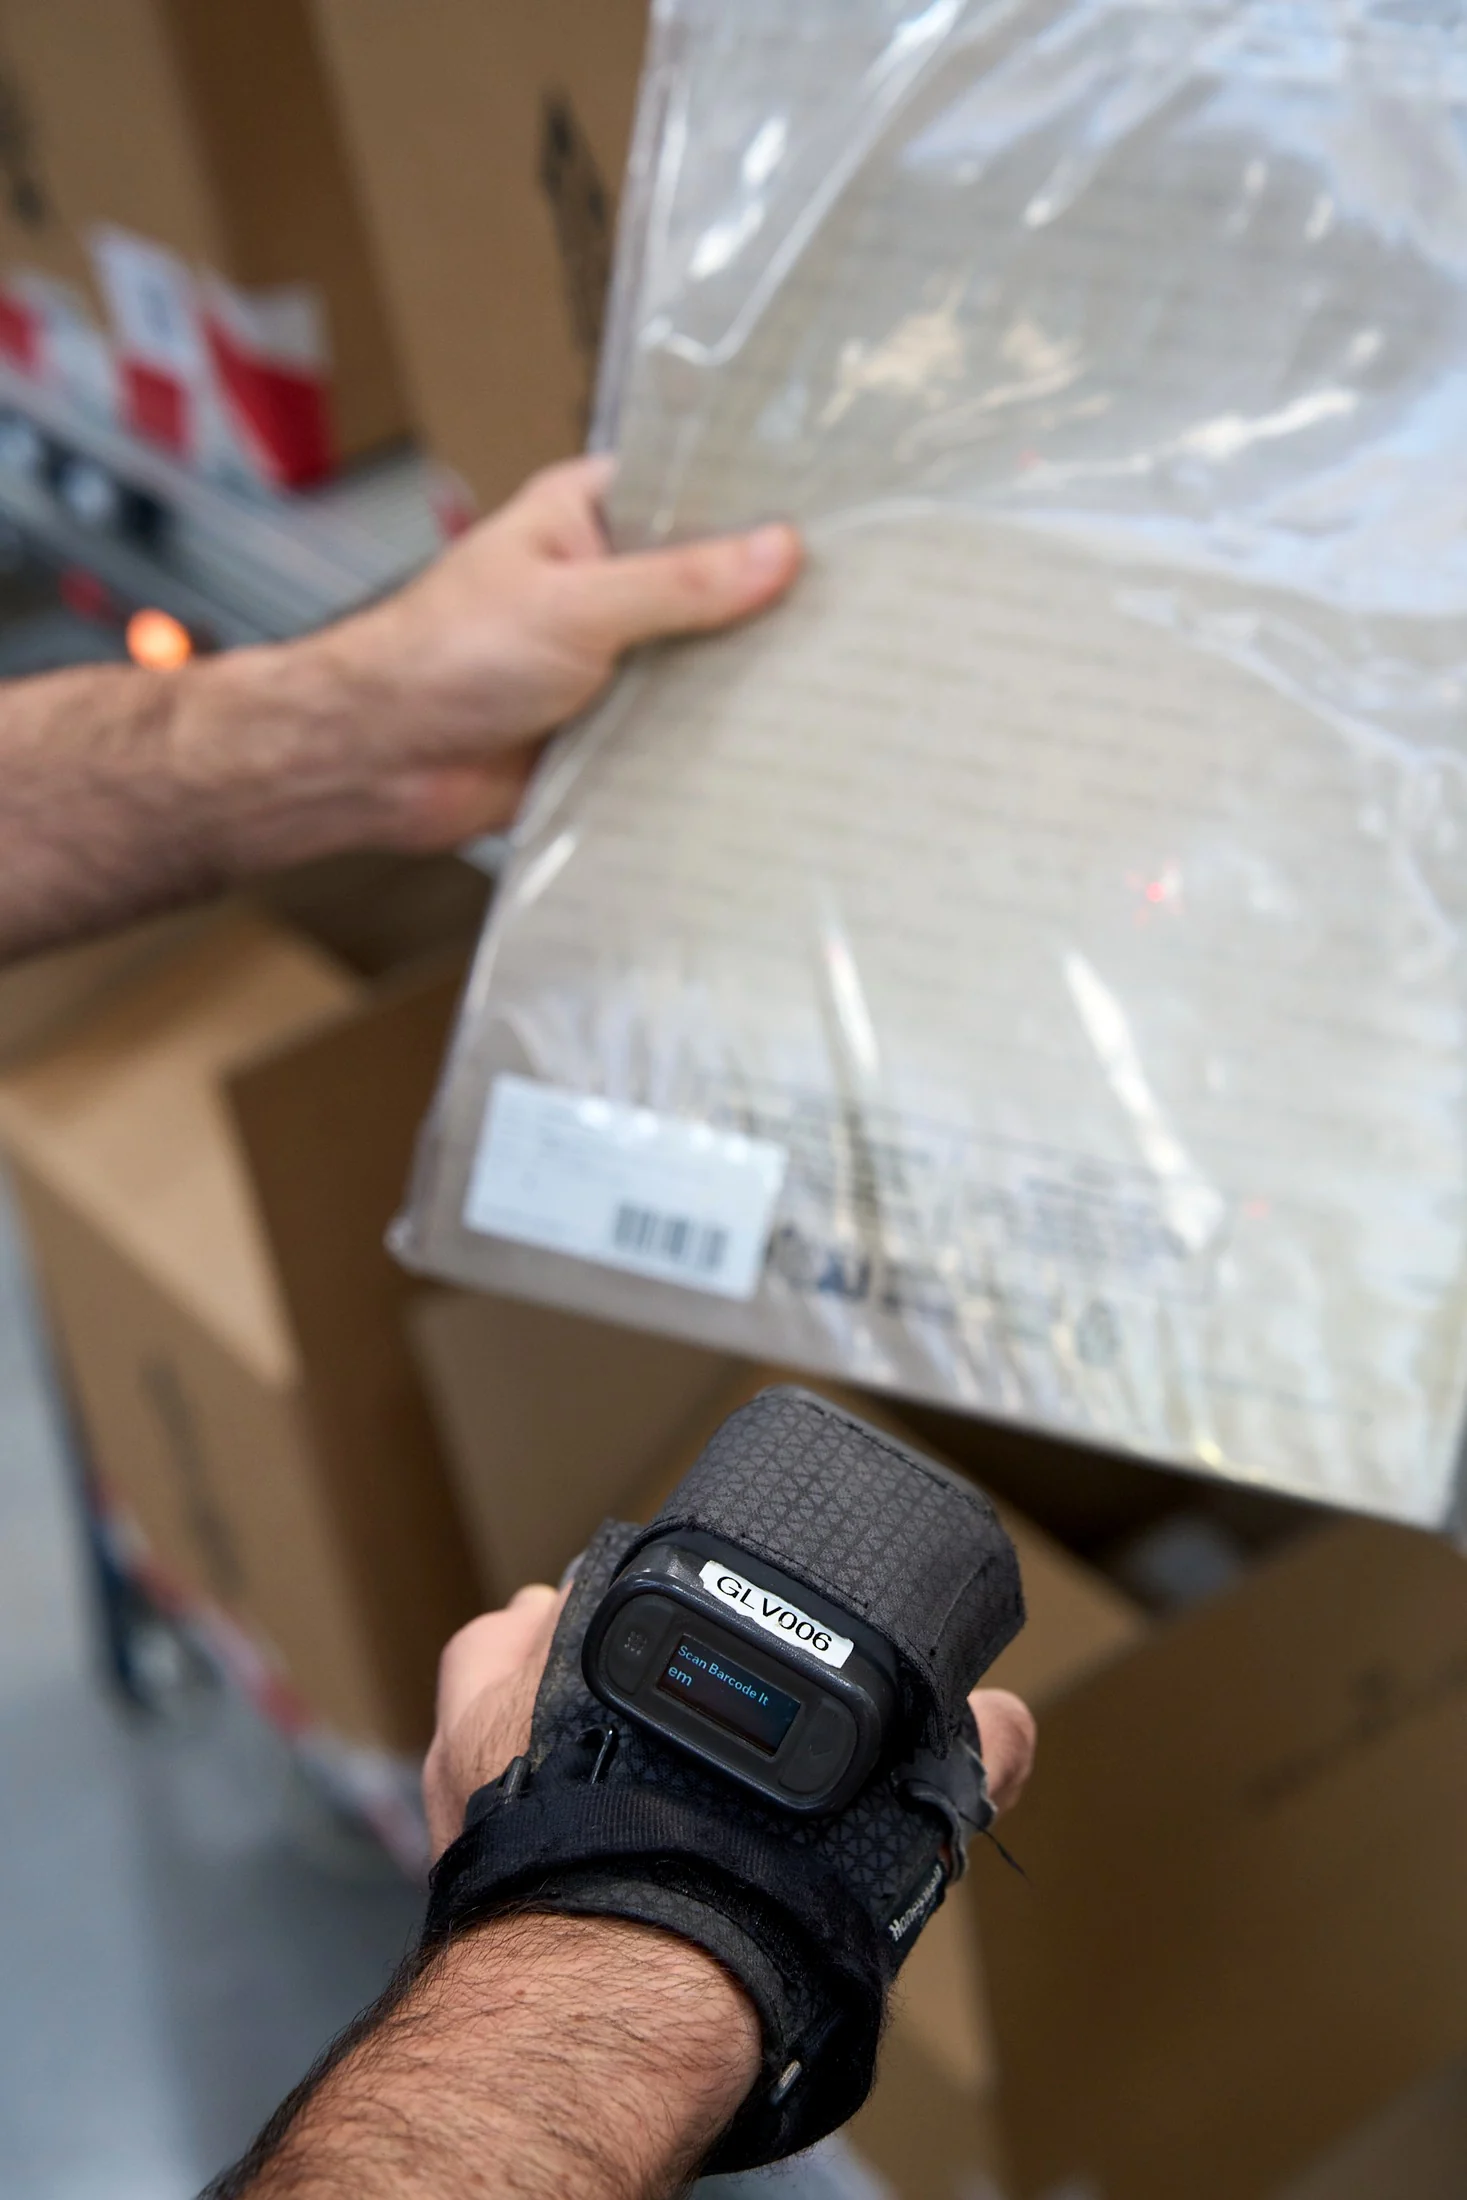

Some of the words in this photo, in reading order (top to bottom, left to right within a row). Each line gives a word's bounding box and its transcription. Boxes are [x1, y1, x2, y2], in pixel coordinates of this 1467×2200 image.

[716, 1575, 833, 1653] GLV006
[667, 1667, 692, 1688] em
[677, 1644, 707, 1671] Scan
[707, 1661, 759, 1700] Barcode
